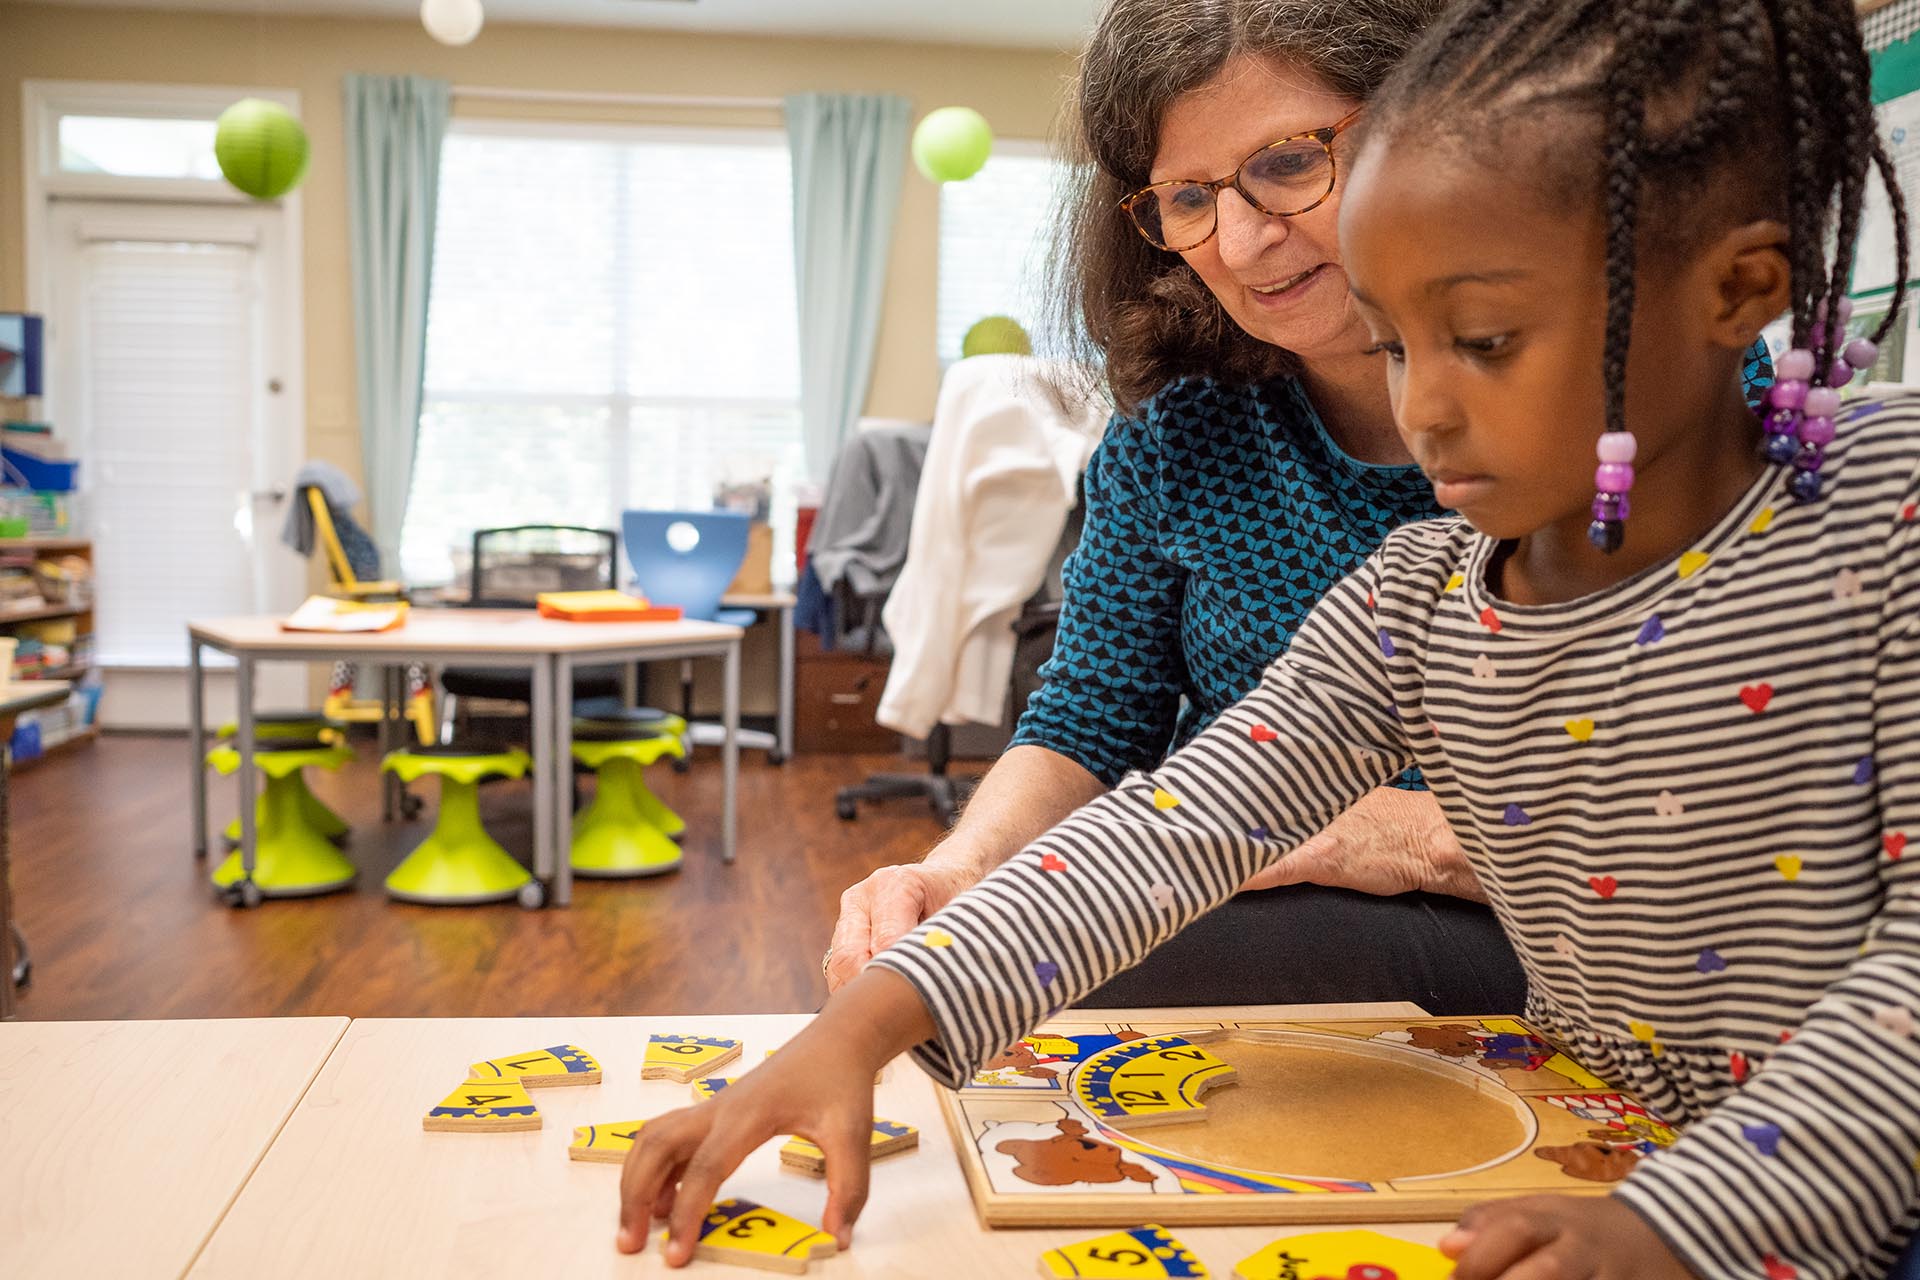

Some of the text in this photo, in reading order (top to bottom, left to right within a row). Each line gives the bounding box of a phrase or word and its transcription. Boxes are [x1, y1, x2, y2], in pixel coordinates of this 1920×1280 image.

[1159, 1050, 1206, 1061] 2
[505, 1057, 551, 1070] 7
[465, 1095, 512, 1106] 4
[1115, 1090, 1170, 1108] 12
[727, 1216, 777, 1238] 3
[1088, 1248, 1148, 1266] 5
